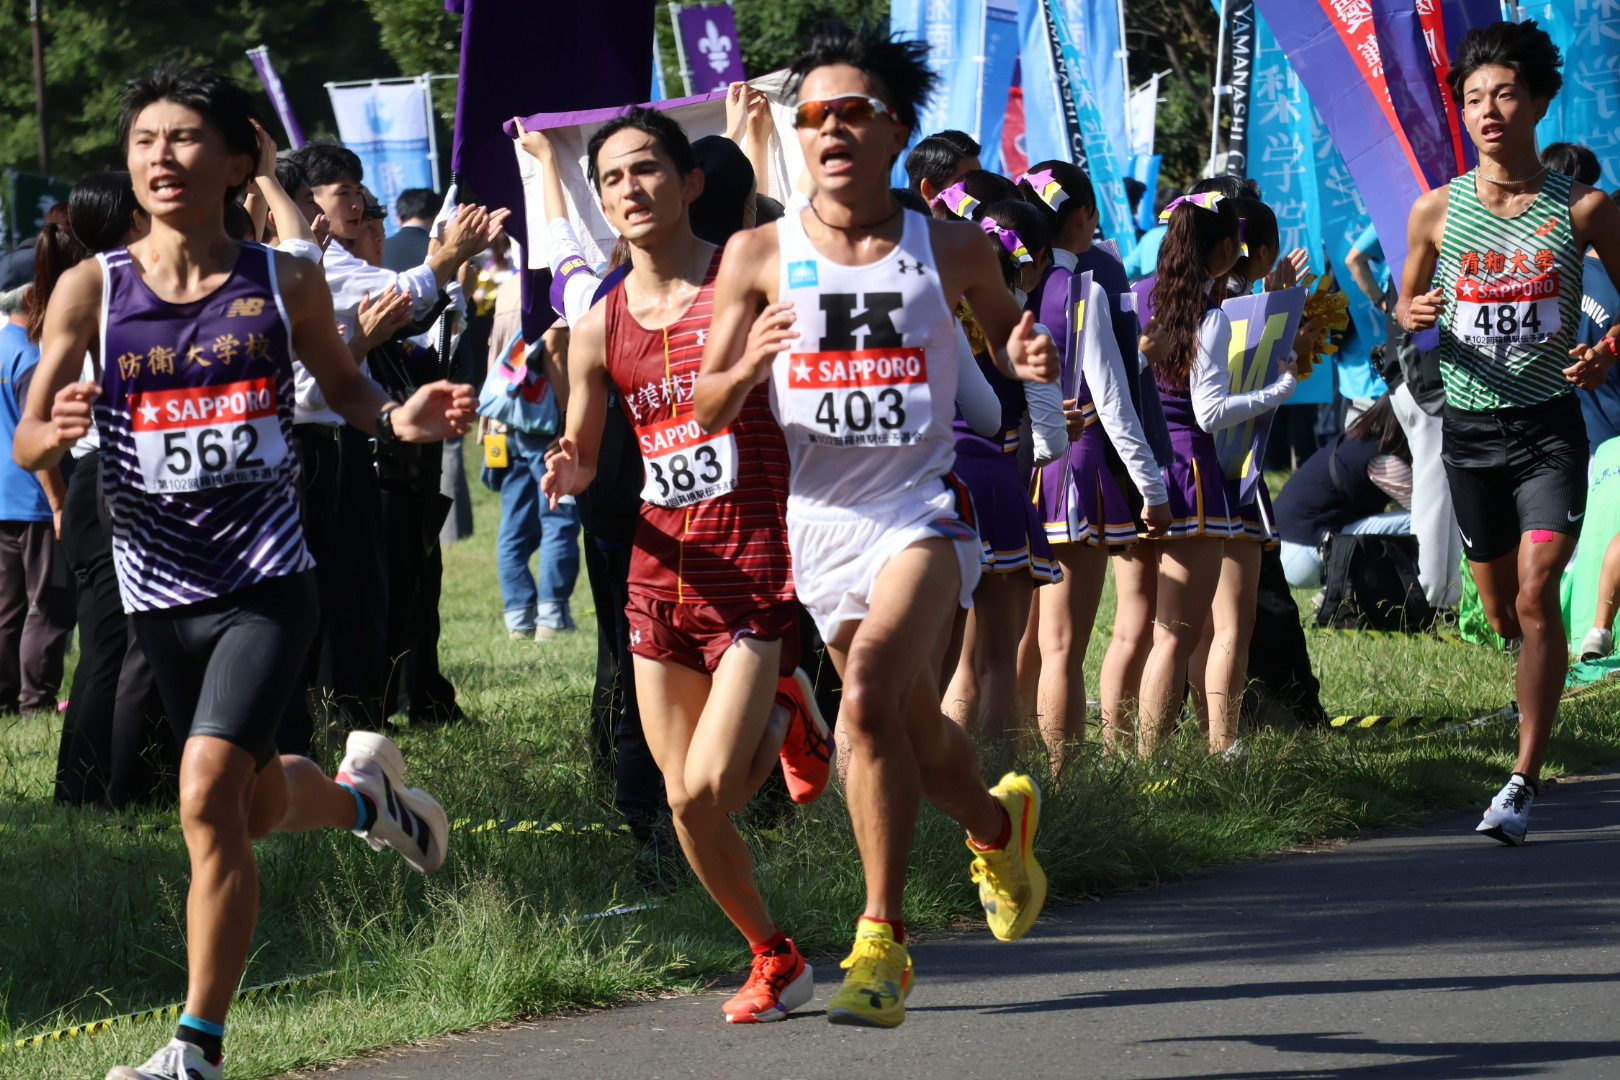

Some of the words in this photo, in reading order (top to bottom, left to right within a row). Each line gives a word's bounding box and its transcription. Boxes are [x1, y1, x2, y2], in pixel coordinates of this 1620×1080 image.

[1230, 4, 1253, 141] YAMANASHI
[1459, 249, 1556, 275] 清和大学
[1478, 279, 1554, 298] SAPPORO
[819, 292, 903, 353] K
[1474, 303, 1541, 336] 484
[1581, 295, 1610, 329] UNIV.
[117, 333, 273, 381] 防衛大学校
[819, 356, 921, 382] SAPPORO
[166, 388, 271, 422] SAPPORO
[815, 388, 906, 433] 403
[164, 424, 265, 475] 562
[640, 420, 708, 454] SAPPO
